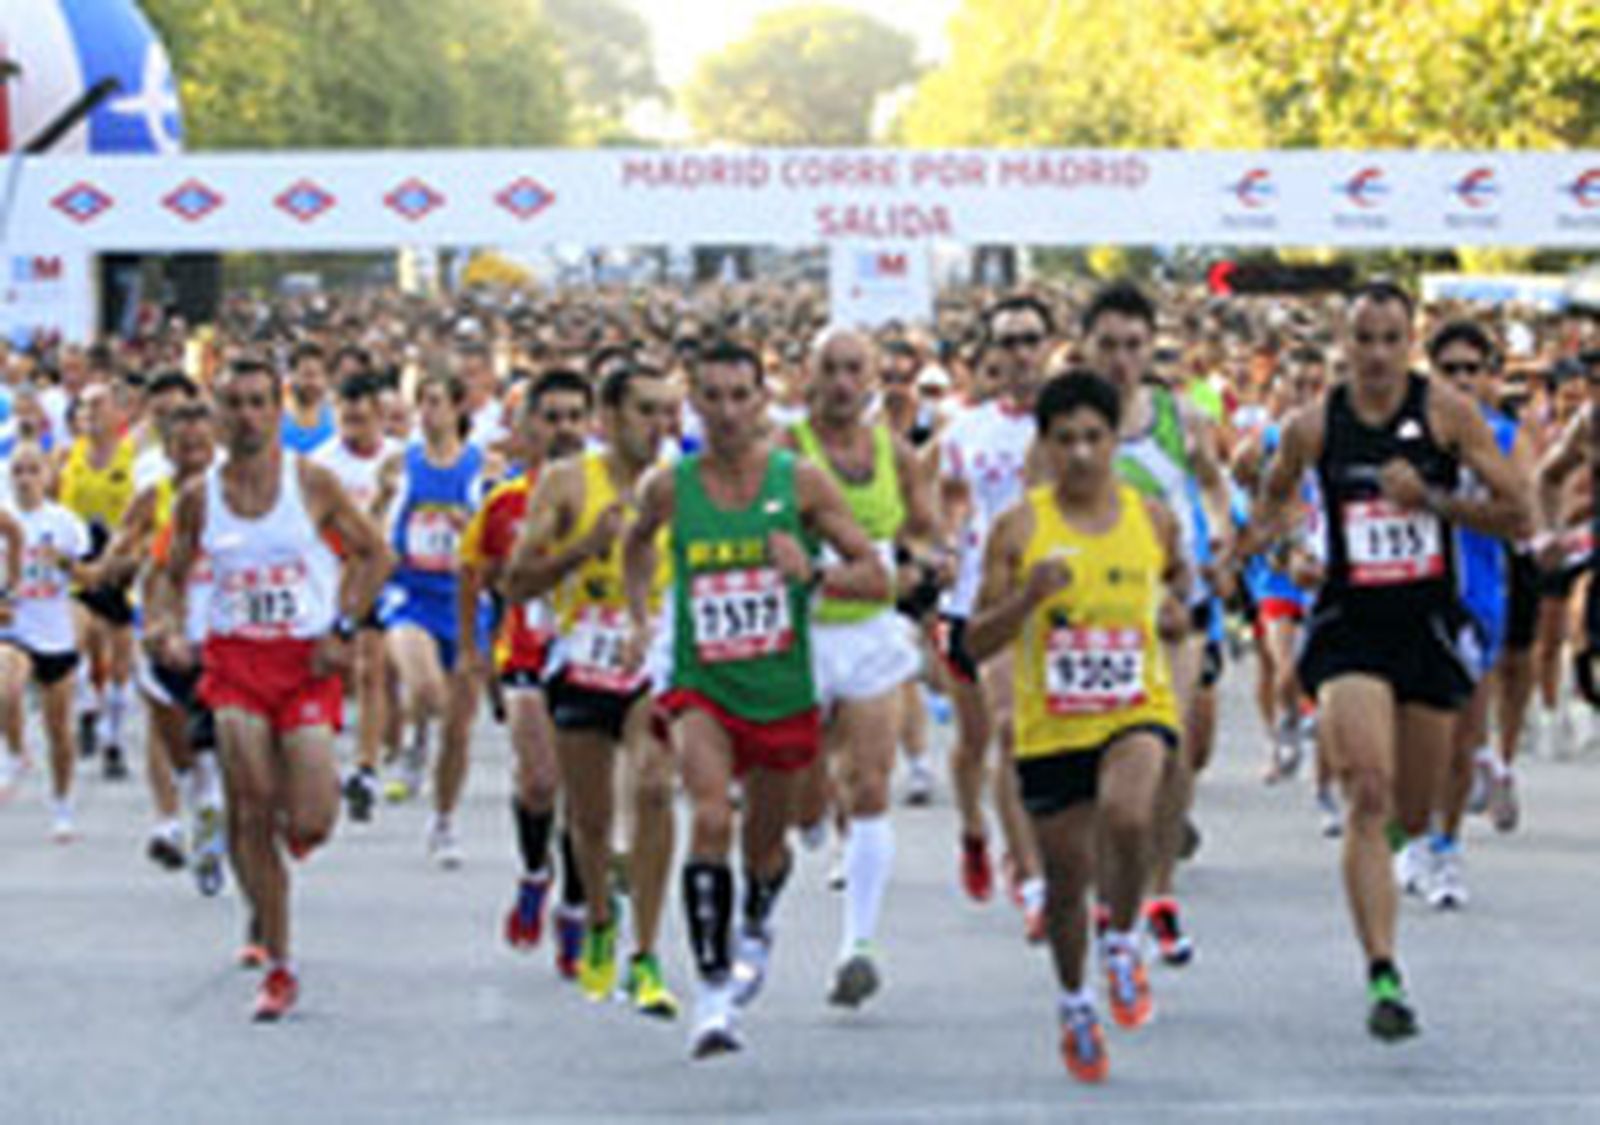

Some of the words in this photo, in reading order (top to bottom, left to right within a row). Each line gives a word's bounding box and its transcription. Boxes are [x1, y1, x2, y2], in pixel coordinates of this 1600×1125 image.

[623, 157, 767, 189] MADRID
[781, 157, 896, 189] CORRE
[910, 157, 984, 188] POR
[1000, 156, 1149, 189] MADRID
[815, 204, 952, 239] SALIDA
